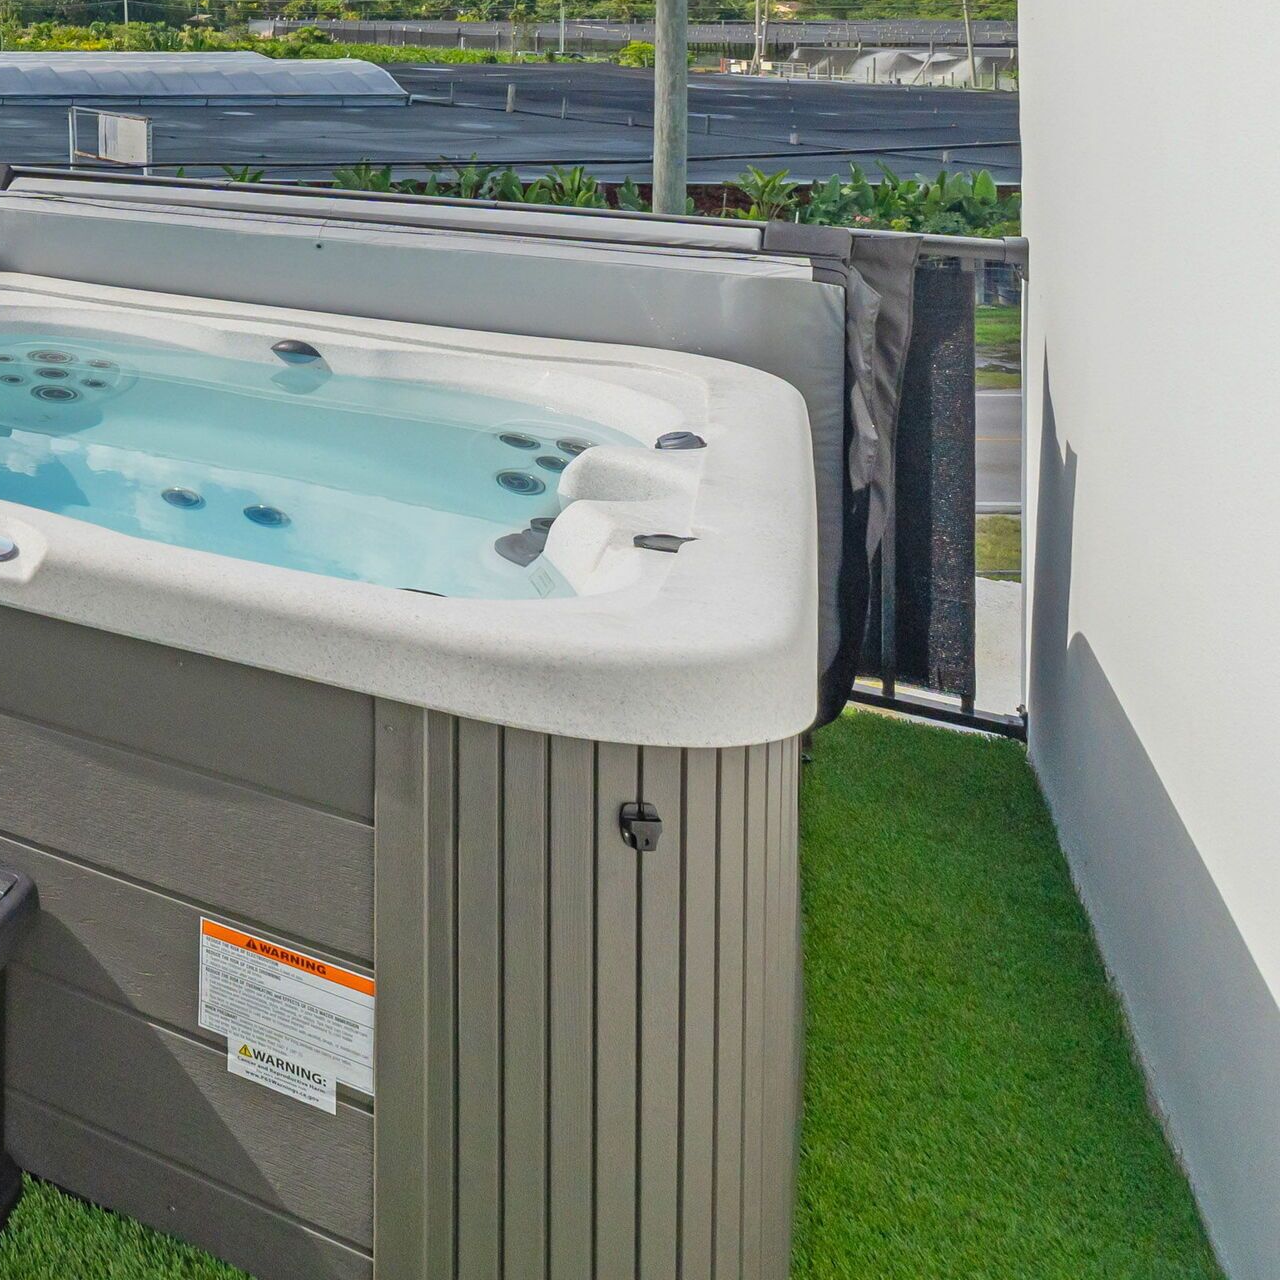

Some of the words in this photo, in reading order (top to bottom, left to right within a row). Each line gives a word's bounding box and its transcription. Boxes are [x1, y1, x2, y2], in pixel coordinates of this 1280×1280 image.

[260, 943, 326, 975] WARNING
[237, 1055, 256, 1067] Cancer
[270, 1068, 308, 1088] Reproductive
[309, 1085, 325, 1095] Harm
[253, 1048, 326, 1087] WARNING:
